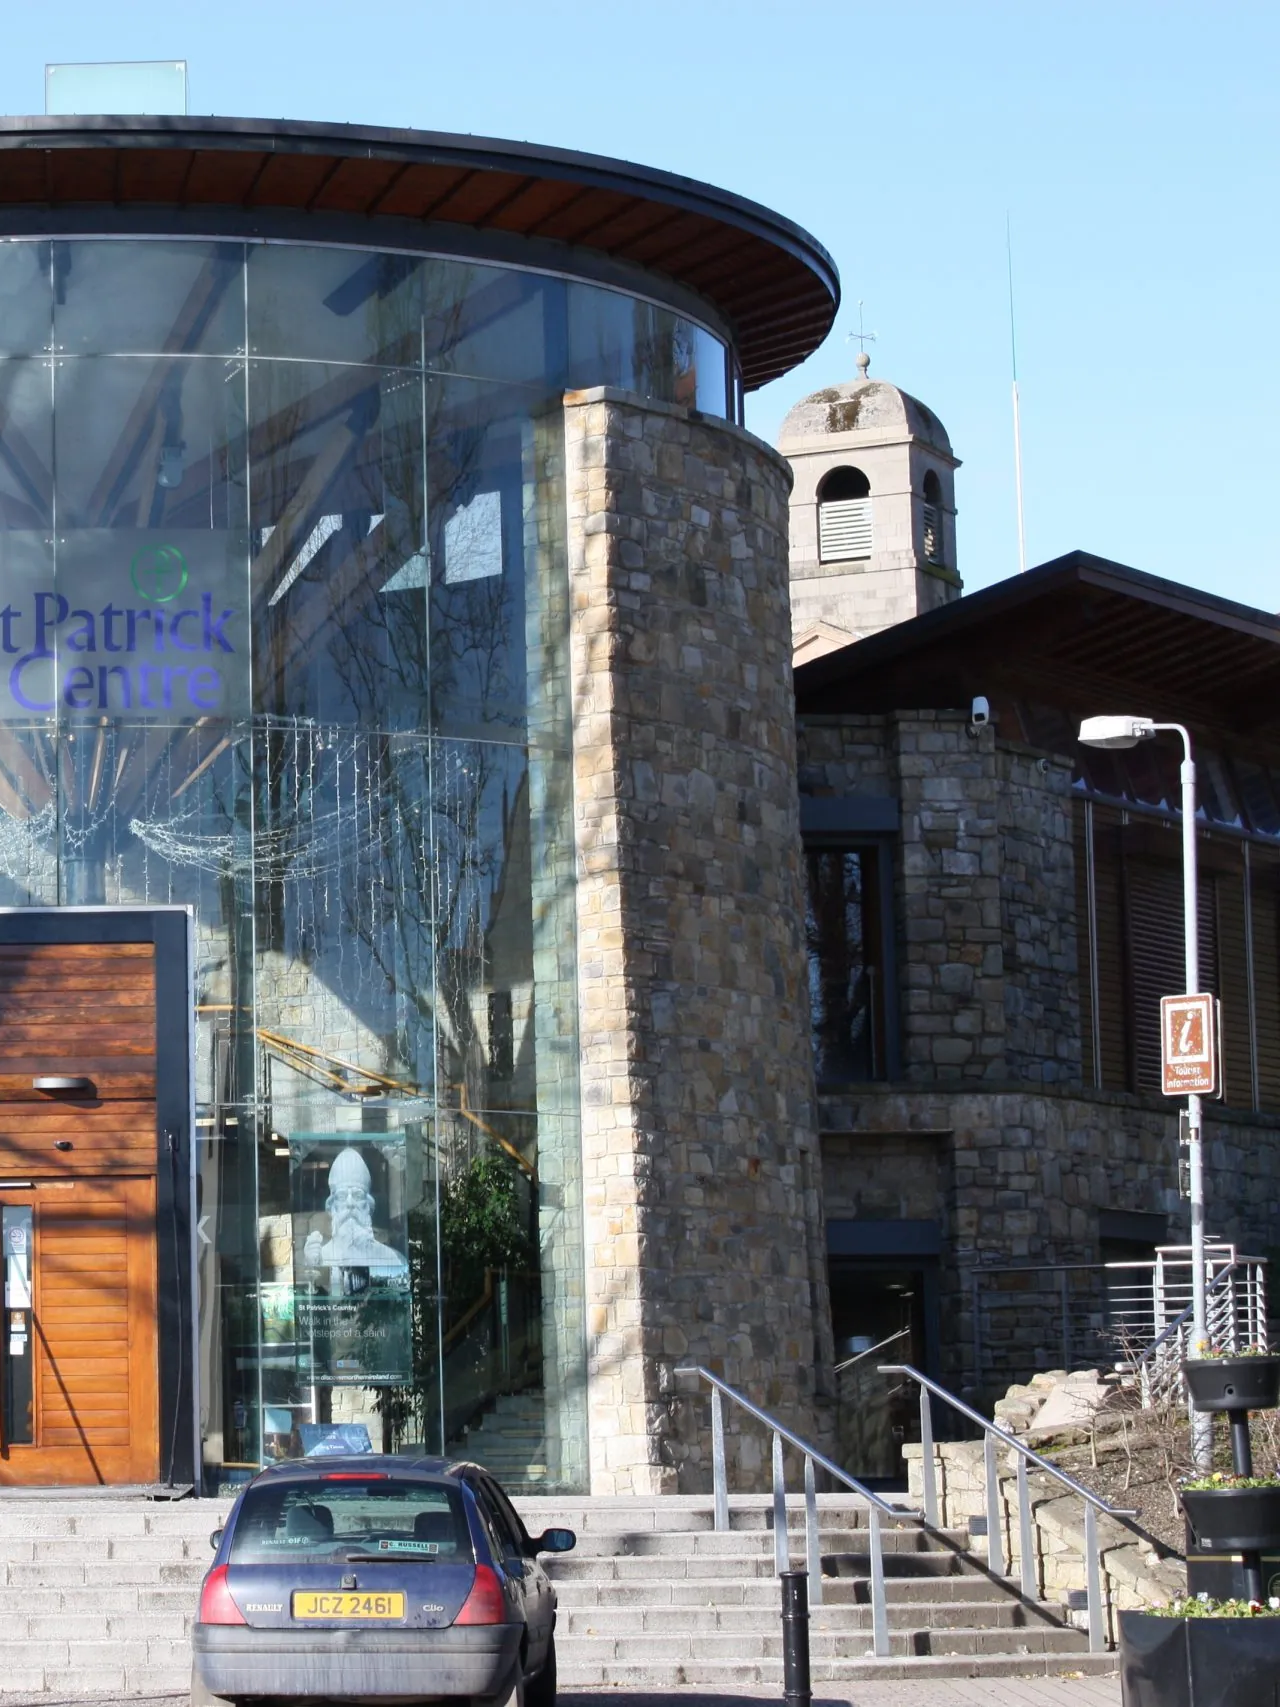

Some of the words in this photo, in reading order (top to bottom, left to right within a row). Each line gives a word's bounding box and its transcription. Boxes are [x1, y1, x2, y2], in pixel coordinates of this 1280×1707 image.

[33, 591, 236, 654] Patrick
[8, 650, 221, 712] Centre
[332, 1304, 357, 1312] Country
[246, 1603, 283, 1613] RENAULT
[307, 1597, 343, 1615] JCZ
[350, 1597, 392, 1615] 2461
[422, 1603, 445, 1613] Clio
